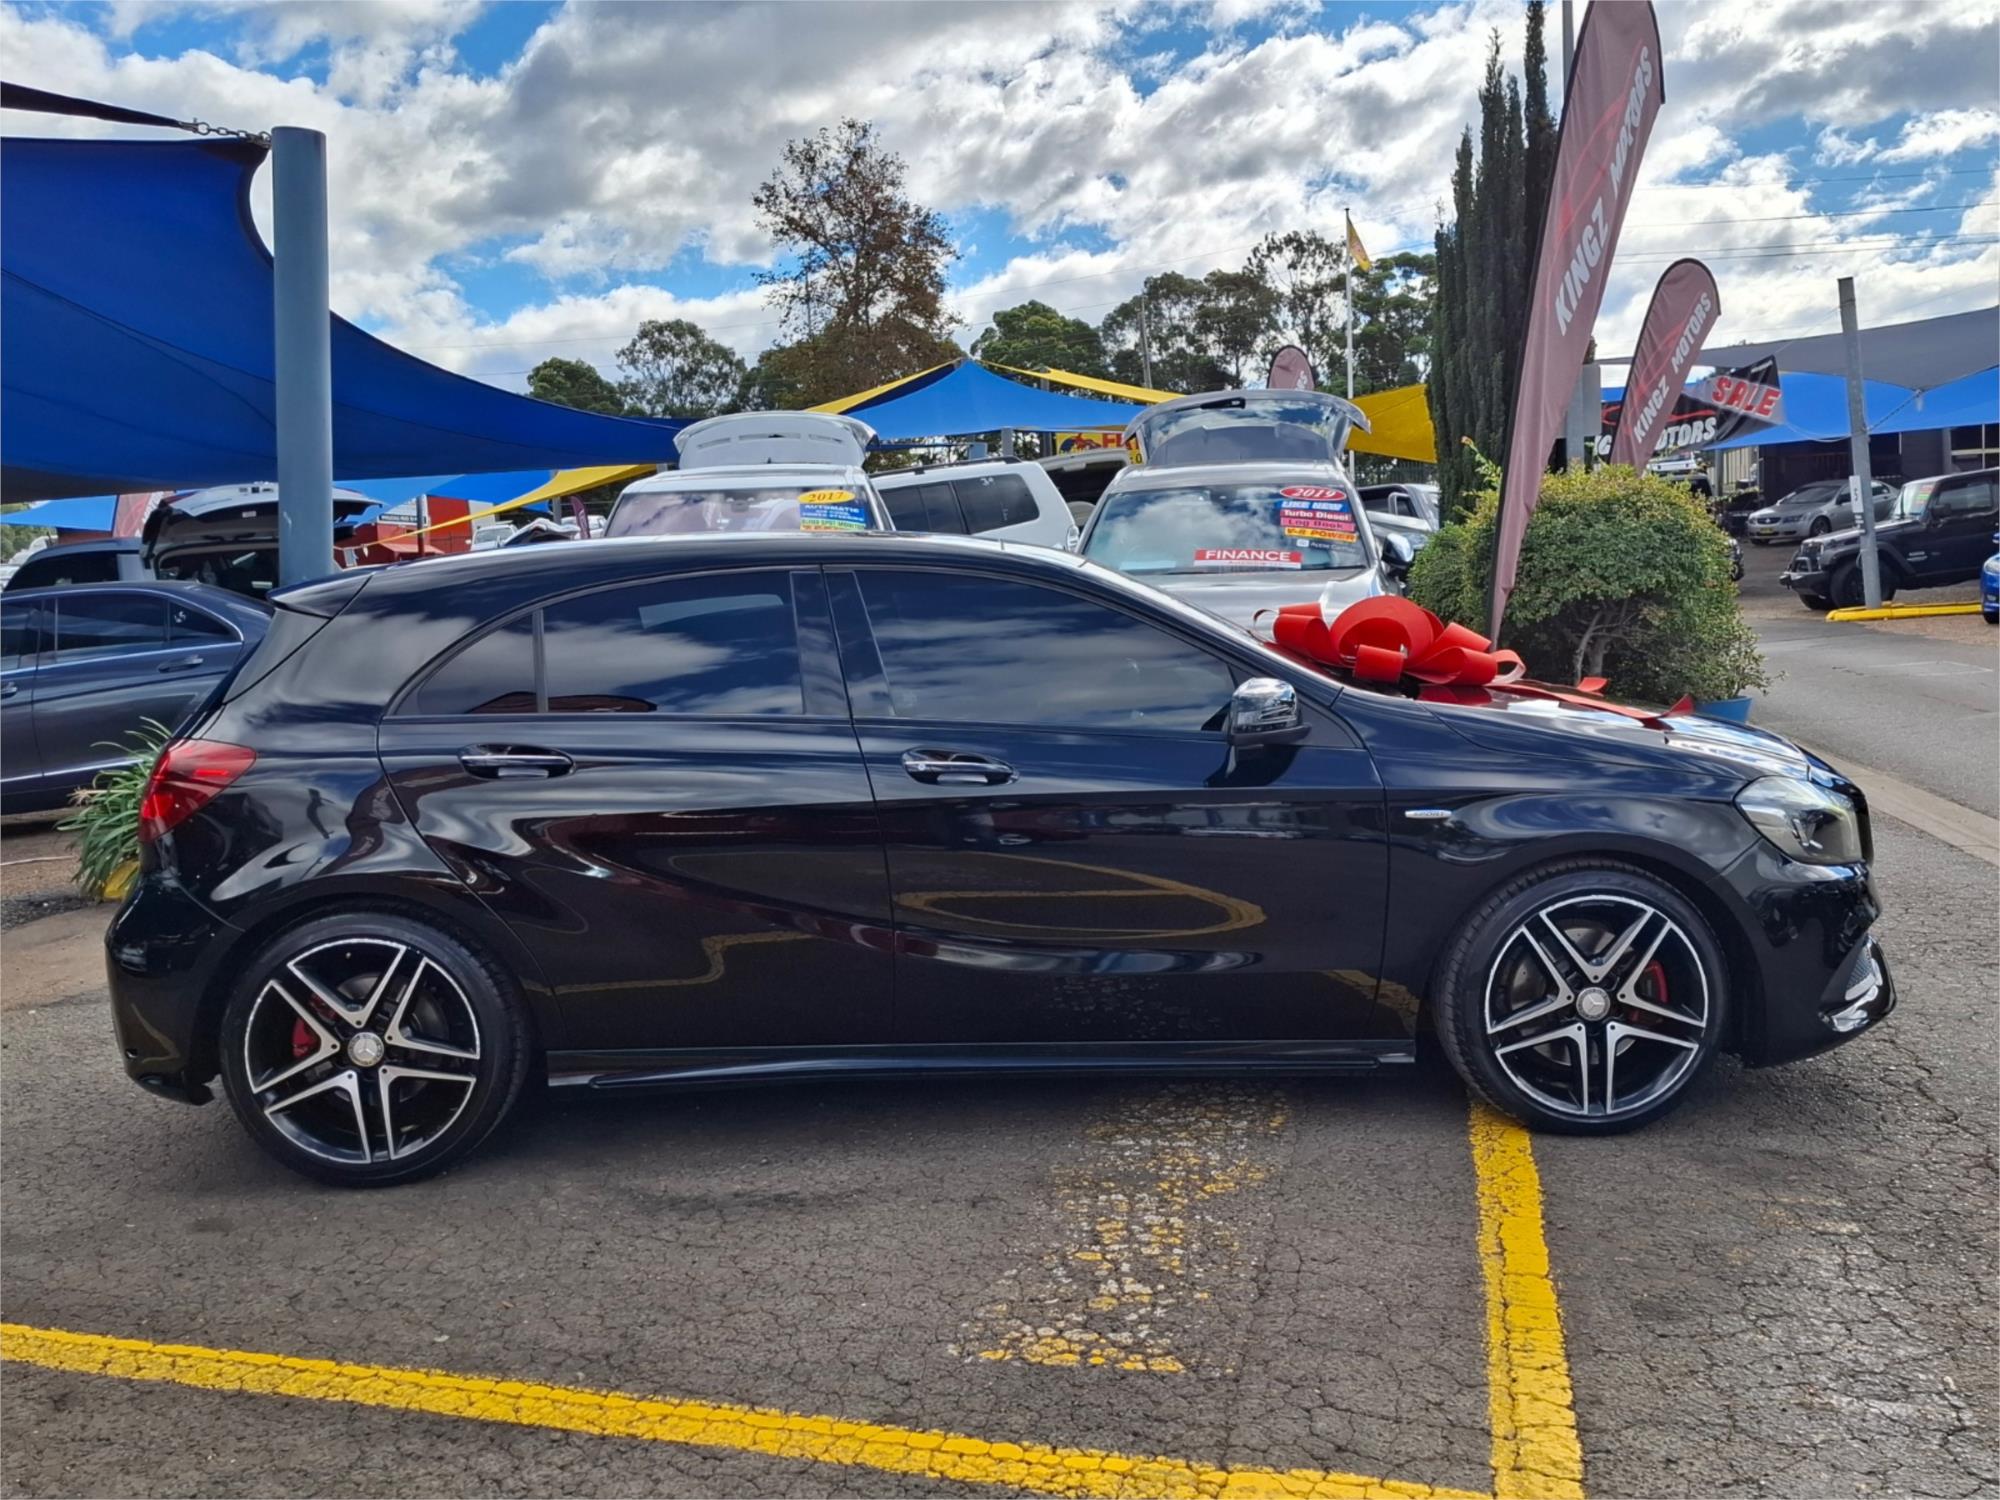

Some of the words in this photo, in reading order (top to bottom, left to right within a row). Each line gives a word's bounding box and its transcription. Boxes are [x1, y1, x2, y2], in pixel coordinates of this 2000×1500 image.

[1555, 196, 1608, 336] KINGZ
[1609, 46, 1652, 200] MOTORS
[1633, 374, 1670, 444] KINGZ
[1671, 291, 1712, 374] MOTORS
[1711, 374, 1782, 417] SALE
[1654, 416, 1718, 451] OTORS
[808, 491, 844, 502] 2017
[1293, 487, 1337, 498] 2019
[1281, 500, 1310, 509] LIKE
[1312, 502, 1343, 511] NEW
[1284, 509, 1313, 518] Turbo
[1315, 511, 1349, 521] Diesel
[1310, 530, 1355, 540] POWER
[1205, 550, 1291, 561] FINANCE
